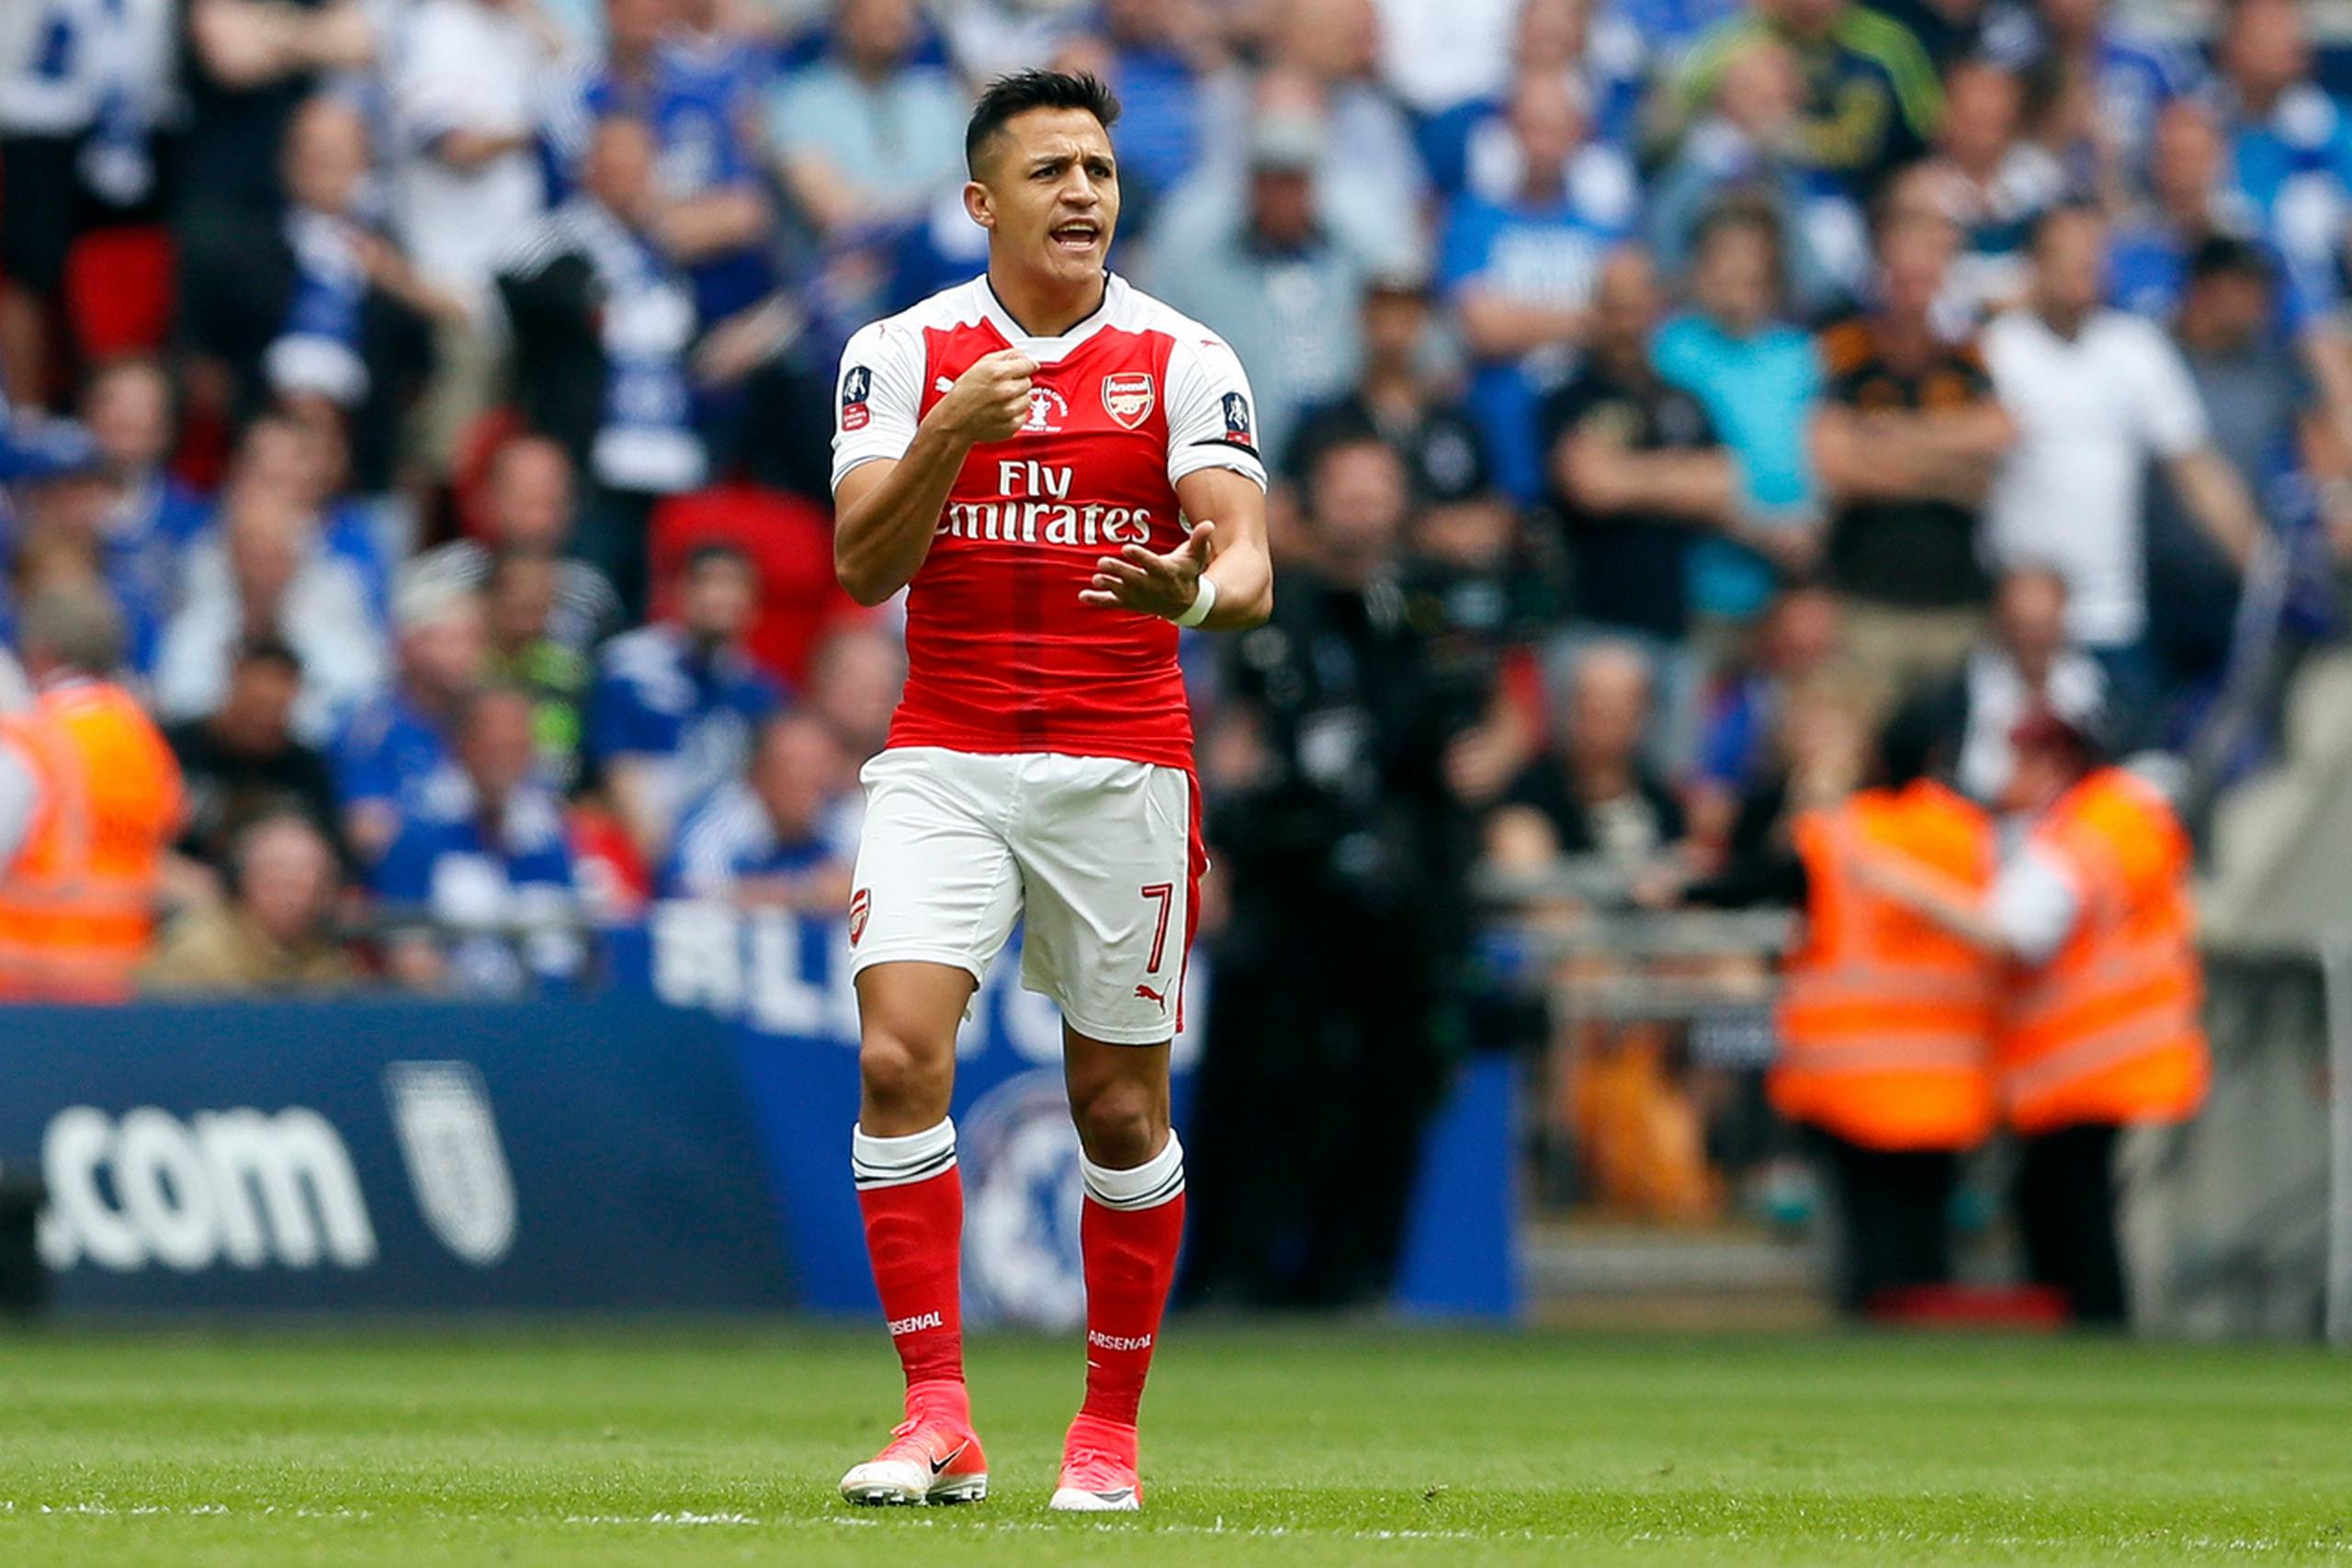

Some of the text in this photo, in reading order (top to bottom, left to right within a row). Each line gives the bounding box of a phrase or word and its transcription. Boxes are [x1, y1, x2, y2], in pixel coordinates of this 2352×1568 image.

[999, 459, 1073, 501] Fly
[934, 502, 1152, 546] mirates
[1141, 883, 1173, 974] 7
[35, 1105, 379, 1271] .com
[888, 1311, 943, 1336] RSENAL
[1088, 1329, 1151, 1351] ARSENAL
